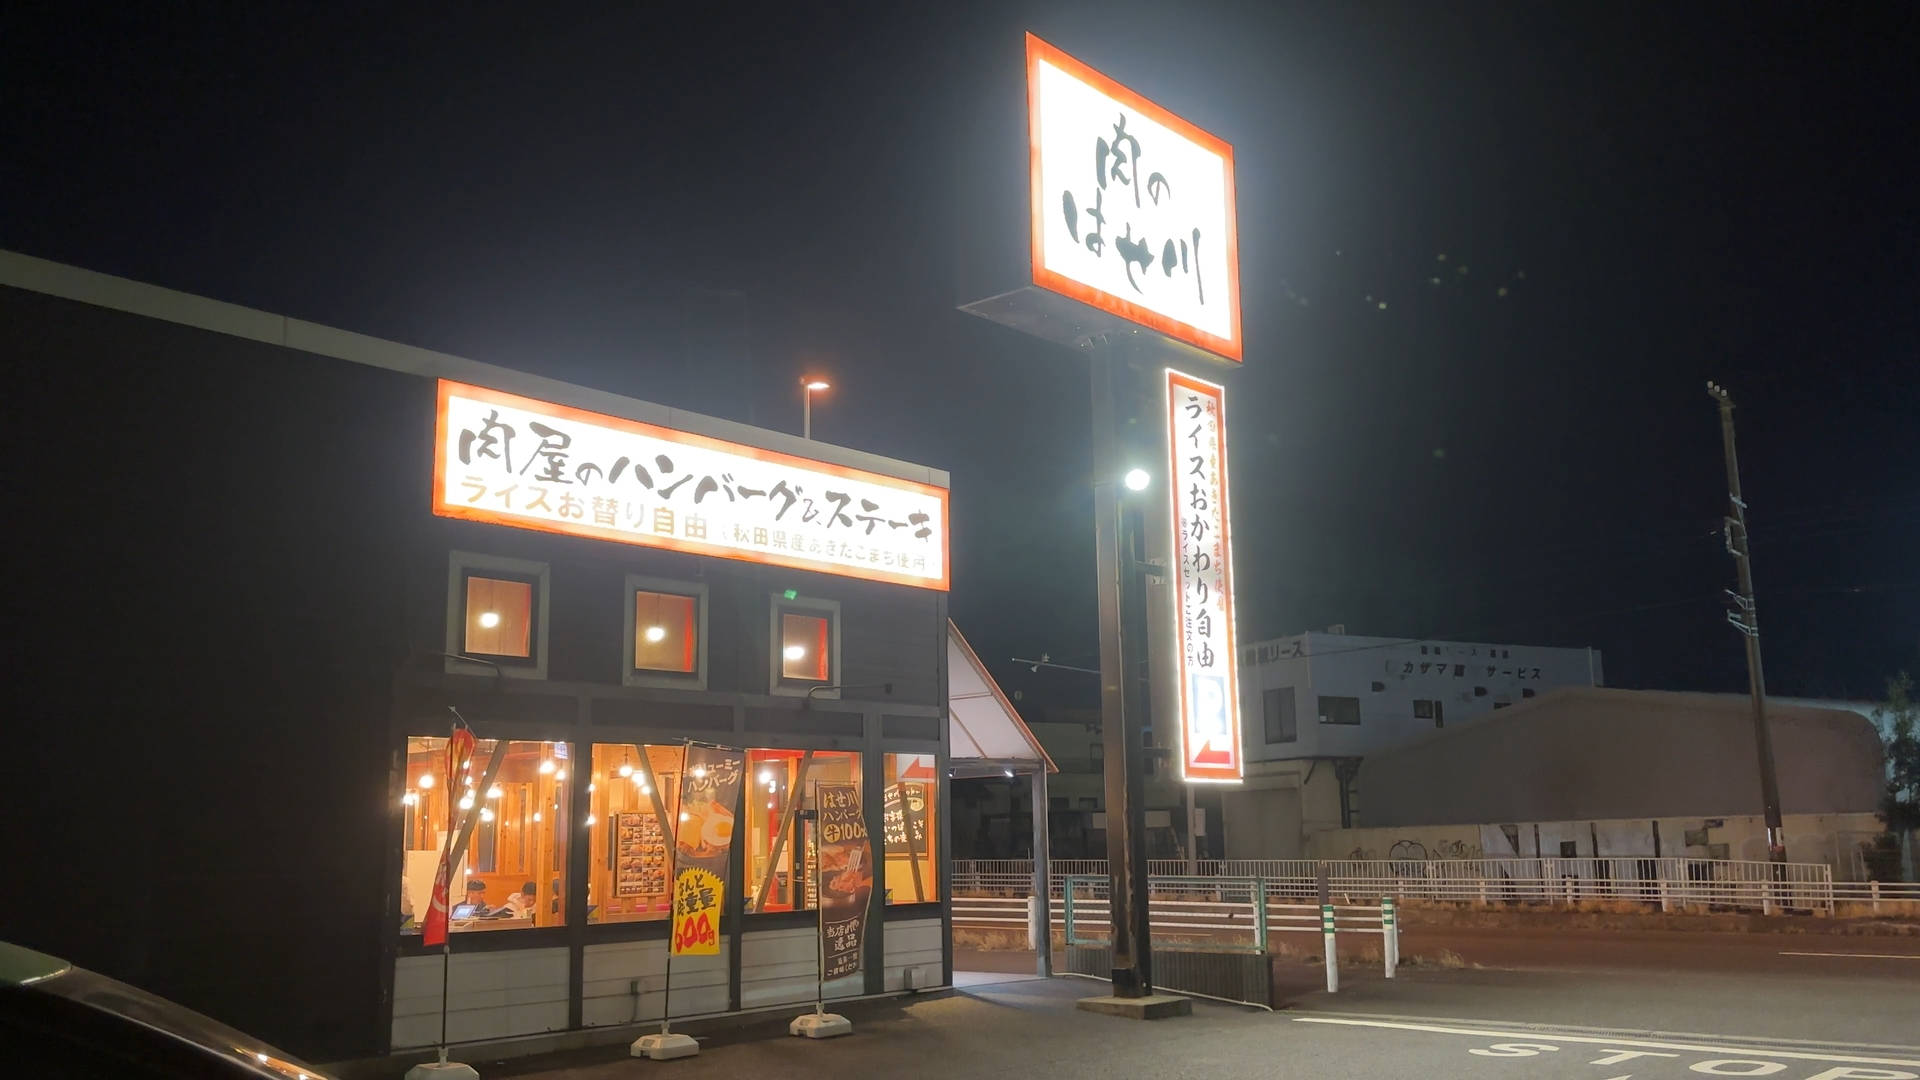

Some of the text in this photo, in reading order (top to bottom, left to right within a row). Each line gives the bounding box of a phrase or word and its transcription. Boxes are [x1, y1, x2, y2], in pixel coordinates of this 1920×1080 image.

[1096, 112, 1171, 208] 肉の
[1062, 187, 1204, 305] はせ川
[461, 475, 708, 541] ライスお替り自由
[1185, 396, 1215, 668] ライスおかわり自由
[688, 768, 740, 793] ハンバーグ
[824, 790, 859, 808] はせ川
